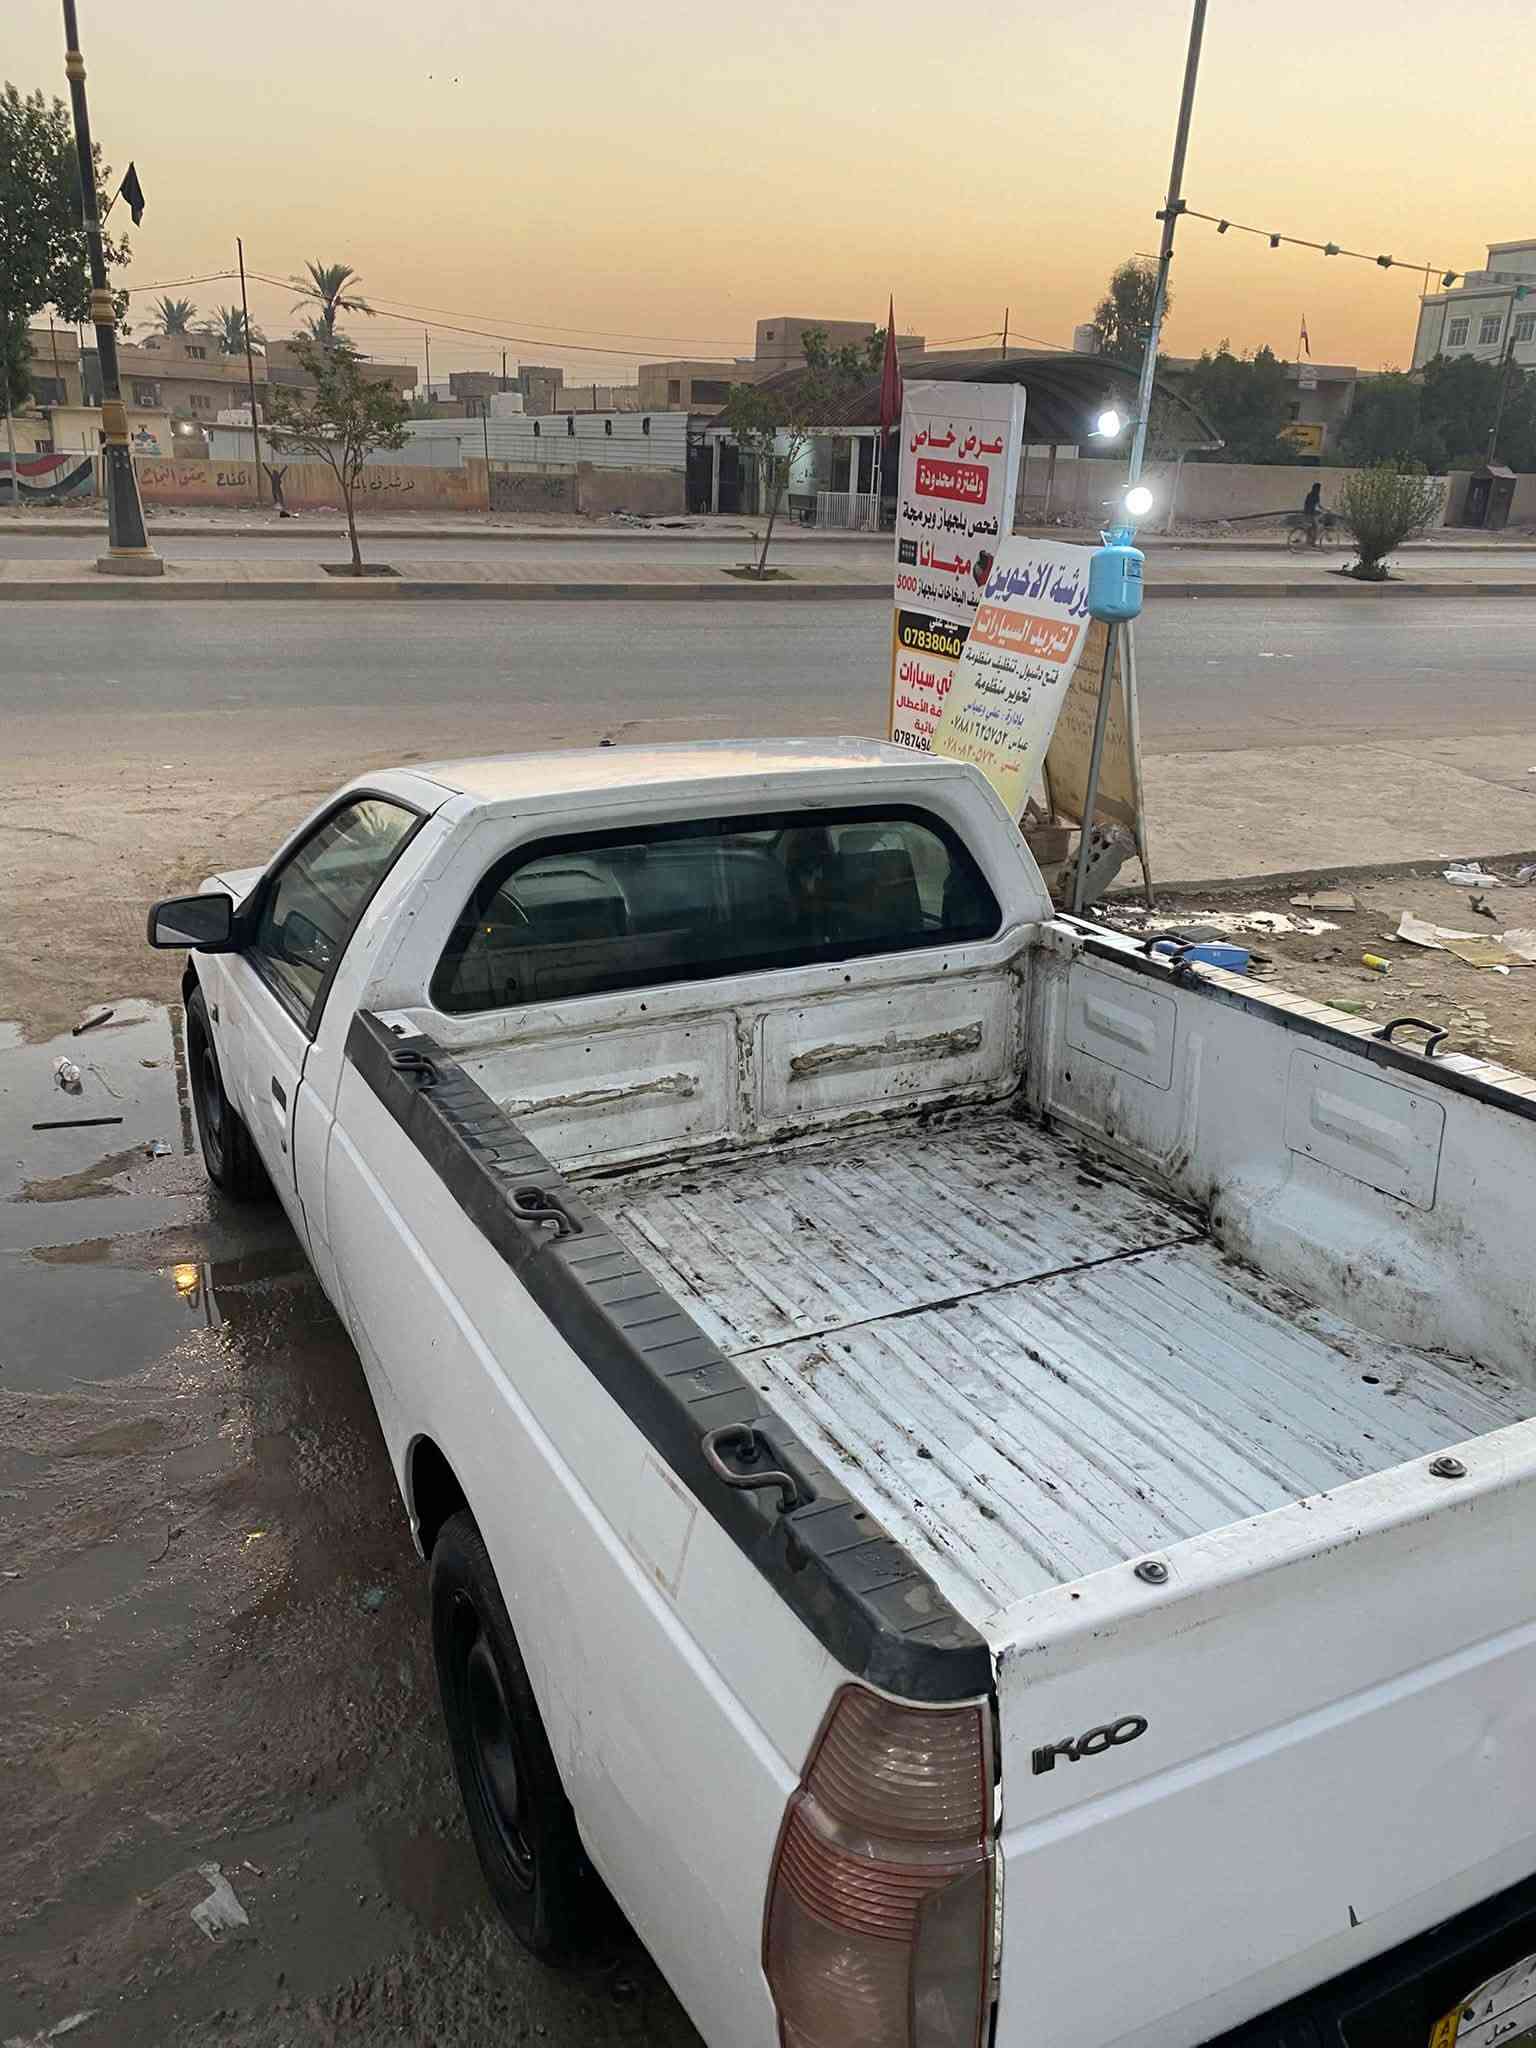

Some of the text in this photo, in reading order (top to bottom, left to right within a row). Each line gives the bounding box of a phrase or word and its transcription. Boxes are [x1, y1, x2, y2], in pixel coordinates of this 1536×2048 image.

[910, 421, 1004, 460] عرض خاص
[919, 464, 985, 499] ولفترة محدودة
[902, 500, 936, 529] وبرمجة
[967, 515, 999, 539] فحص
[896, 574, 918, 593] 5000
[976, 608, 1033, 646] السيارات
[899, 661, 936, 692] سيارات
